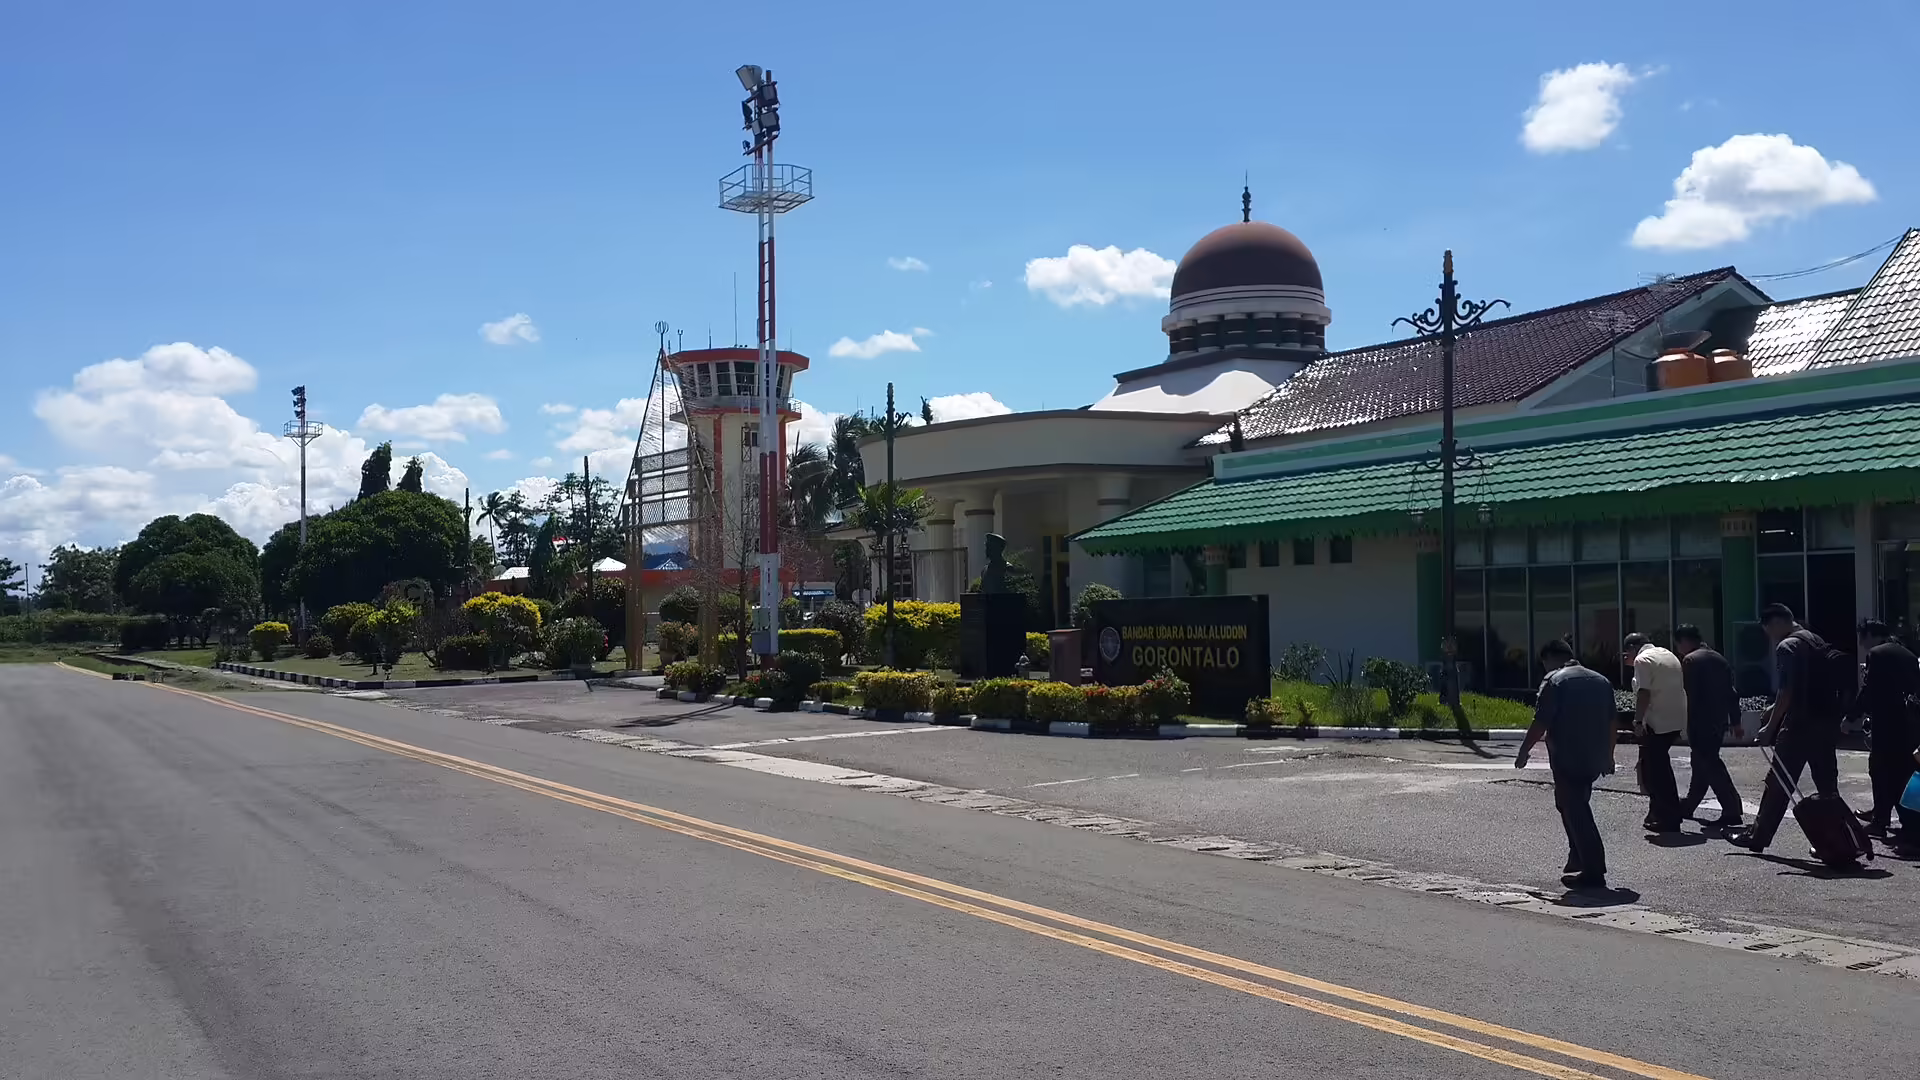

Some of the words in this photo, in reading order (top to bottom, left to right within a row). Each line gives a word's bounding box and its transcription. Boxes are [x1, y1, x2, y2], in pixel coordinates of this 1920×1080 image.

[1121, 625, 1154, 641] BANDAR
[1157, 624, 1185, 640] UDARA
[1186, 623, 1248, 640] DJALALUDDIN
[1132, 645, 1240, 669] GORONTALO
